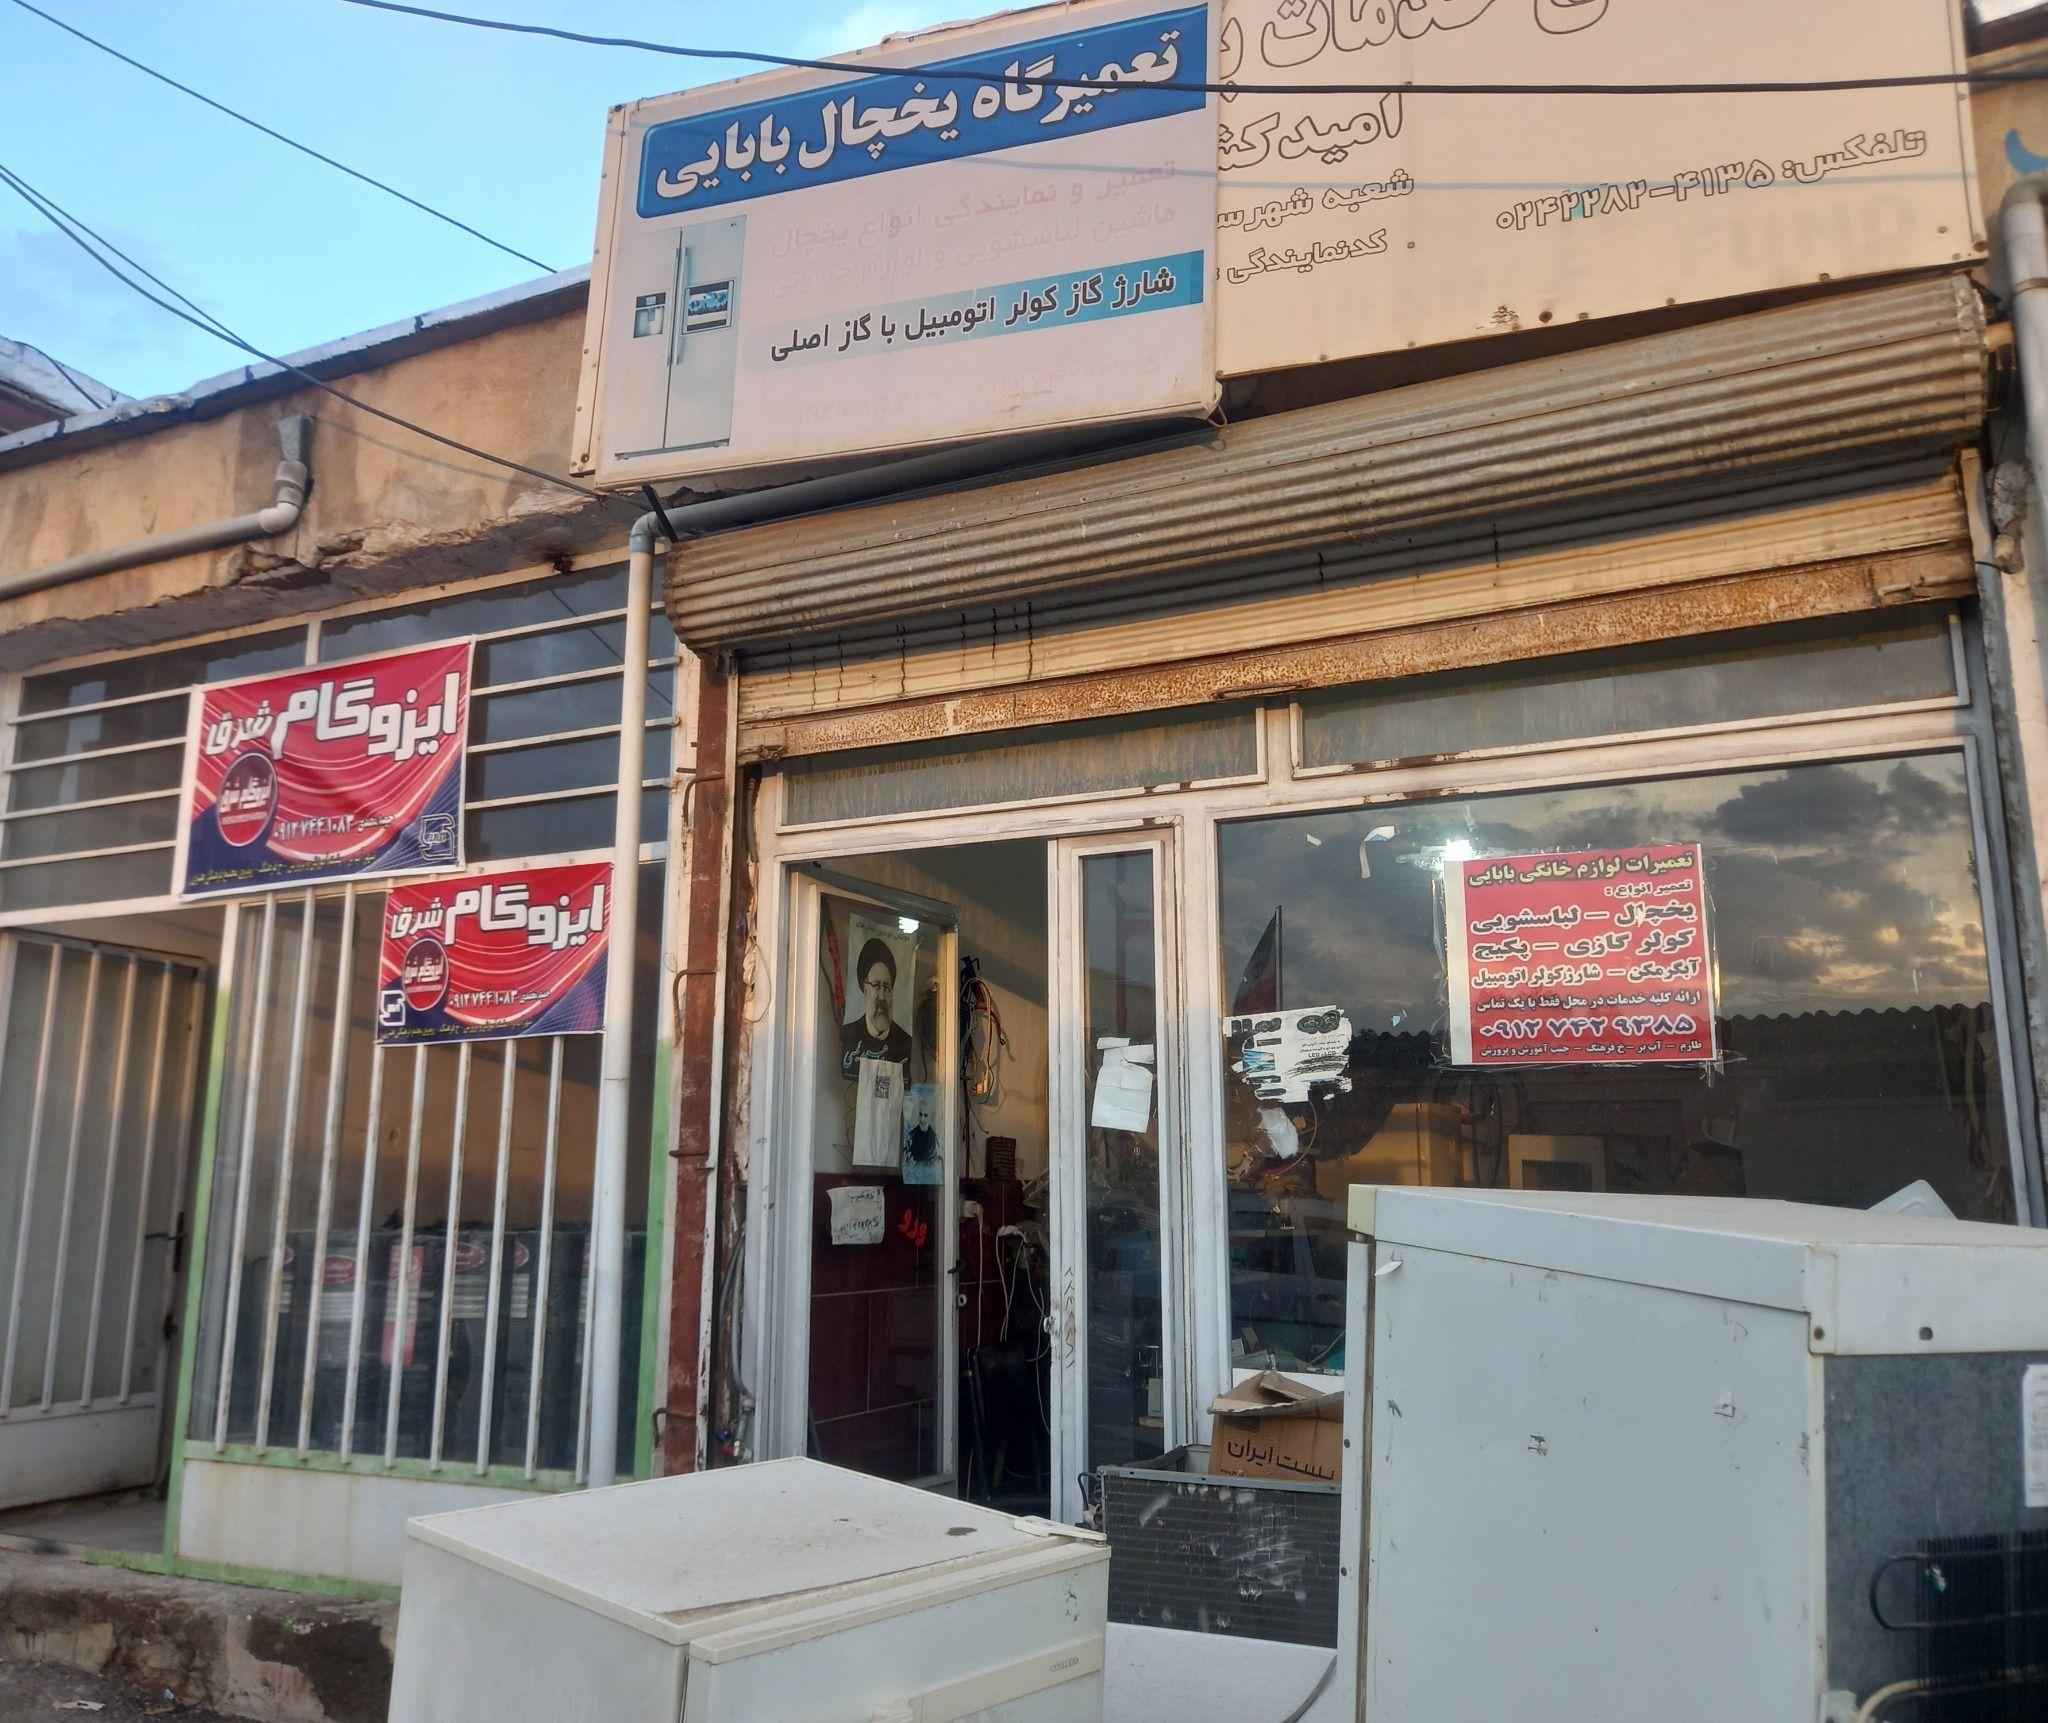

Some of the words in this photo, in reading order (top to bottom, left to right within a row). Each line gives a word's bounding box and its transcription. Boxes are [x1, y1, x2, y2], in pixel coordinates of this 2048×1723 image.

[973, 29, 1182, 127] تعمیرگاه
[797, 81, 960, 170] یخچال
[656, 115, 793, 199] بابایی
[1782, 129, 1928, 184] تلفکس:
[1321, 168, 1415, 213] شعبه
[1069, 271, 1104, 317] گاز
[1112, 266, 1176, 309] شارژ
[1004, 284, 1058, 328] کولر
[880, 314, 897, 343] با
[905, 298, 995, 342] اتومبیل
[770, 327, 829, 363] اصلی
[838, 313, 872, 353] گاز
[204, 699, 275, 756] شرق
[271, 672, 460, 762] ایزوگام
[1519, 859, 1572, 883] خانگی
[1576, 857, 1623, 879] لوازم
[1626, 852, 1693, 874] تعمیرات
[1469, 864, 1515, 887] بابایی
[1656, 880, 1692, 895] تعمیر
[389, 897, 445, 940] شرق
[444, 884, 606, 951] ایزوگام
[1471, 906, 1579, 933] لباسشویی
[1616, 900, 1696, 925] یخچال
[1473, 937, 1529, 960] پکیج
[1566, 933, 1630, 956] گازی
[1637, 929, 1694, 953] کولر
[1473, 968, 1526, 988] اتومبیل
[1629, 958, 1700, 980] آبگرمکن
[1476, 998, 1505, 1012] تماس
[1507, 997, 1526, 1012] یک
[1528, 997, 1537, 1010] با
[1540, 994, 1561, 1009] فقط
[1562, 995, 1588, 1009] محل
[1592, 997, 1606, 1010] در
[1608, 993, 1646, 1006] خدمات
[1650, 992, 1672, 1005] کلیه
[1674, 990, 1701, 1005] ارائه
[1481, 1018, 1542, 1039] ۰۹۱۲
[1546, 1016, 1607, 1037] ۷۴۲
[1612, 1014, 1696, 1037] ۹۳۸۵
[1586, 1041, 1615, 1053] فرهنگ
[1679, 1040, 1703, 1052] طارم
[1226, 1439, 1275, 1467] ایران
